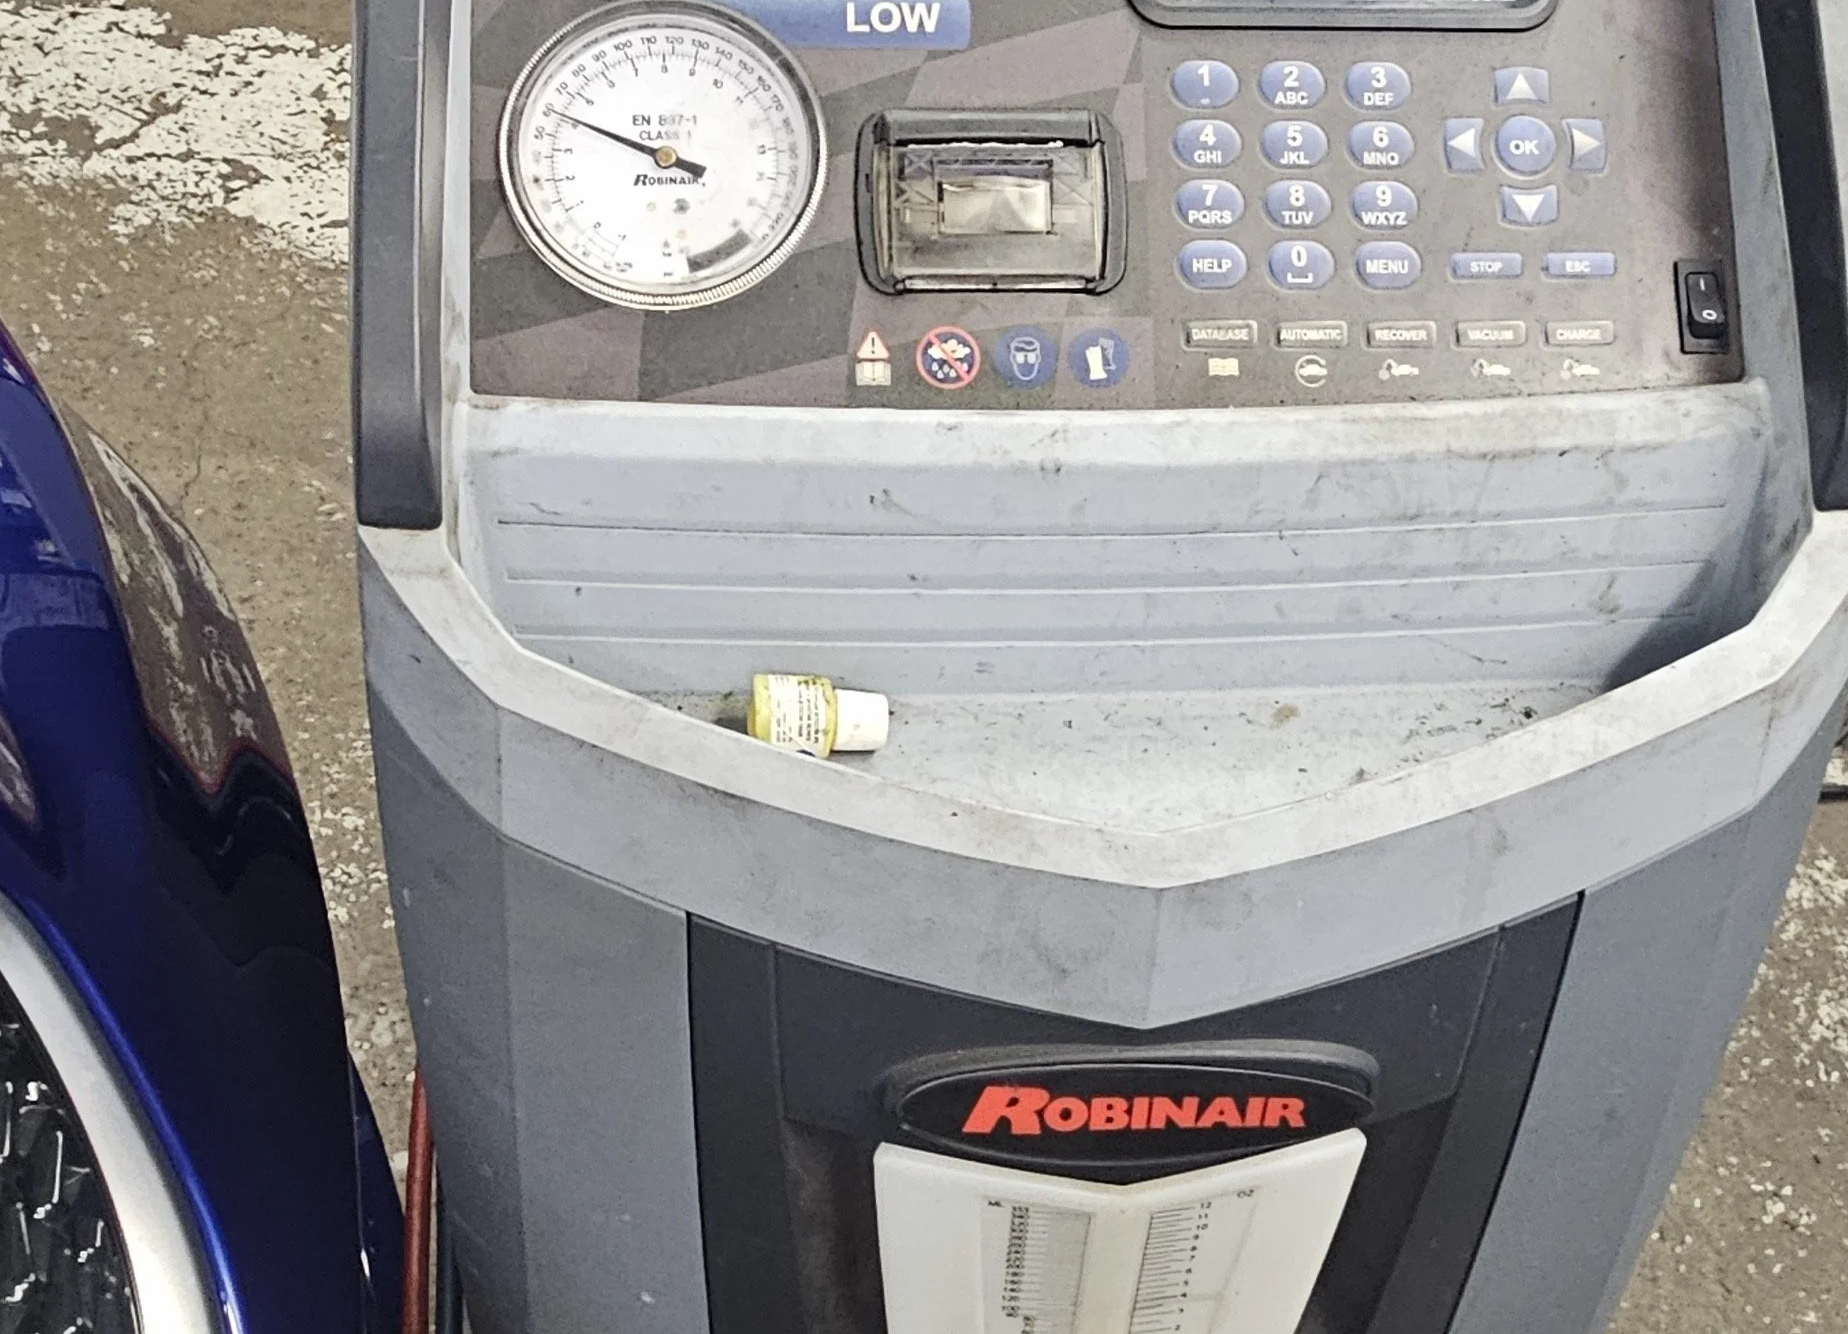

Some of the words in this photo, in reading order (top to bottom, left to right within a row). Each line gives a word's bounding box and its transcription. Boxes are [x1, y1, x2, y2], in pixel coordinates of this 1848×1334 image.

[846, 2, 940, 33] LOW
[613, 39, 633, 52] 100
[665, 35, 684, 45] 120
[1198, 65, 1210, 87] 1
[1283, 66, 1299, 88] 2
[1371, 67, 1386, 88] 3
[1274, 92, 1309, 106] ABC
[1364, 92, 1394, 106] DEF
[632, 114, 651, 126] EN
[639, 130, 680, 141] CLASS
[1199, 125, 1216, 146] 4
[1287, 126, 1302, 147] 5
[1373, 127, 1388, 148] 6
[1509, 140, 1539, 155] OK
[1194, 151, 1222, 164] GHI
[1280, 151, 1310, 165] JKL
[1363, 152, 1399, 166] MNO
[633, 174, 699, 186] ROBINAIR
[1202, 184, 1218, 207] 7
[1290, 185, 1305, 207] 8
[1376, 185, 1392, 207] 9
[1188, 210, 1233, 225] PQRS
[1282, 211, 1313, 225] TUV
[1361, 212, 1407, 226] WXYZ
[1291, 245, 1307, 267] 0
[1192, 258, 1233, 273] HELP
[1366, 260, 1409, 274] MENU
[1470, 261, 1503, 273] STOP
[1565, 261, 1590, 272] ESC
[1191, 328, 1250, 342] DATABASE
[1280, 329, 1342, 341] AUTOMATIC
[1375, 329, 1427, 341] RECOVER
[1467, 329, 1514, 341] VACUUM
[1555, 329, 1602, 341] CHARGE
[961, 1085, 1307, 1136] ROBINAIR
